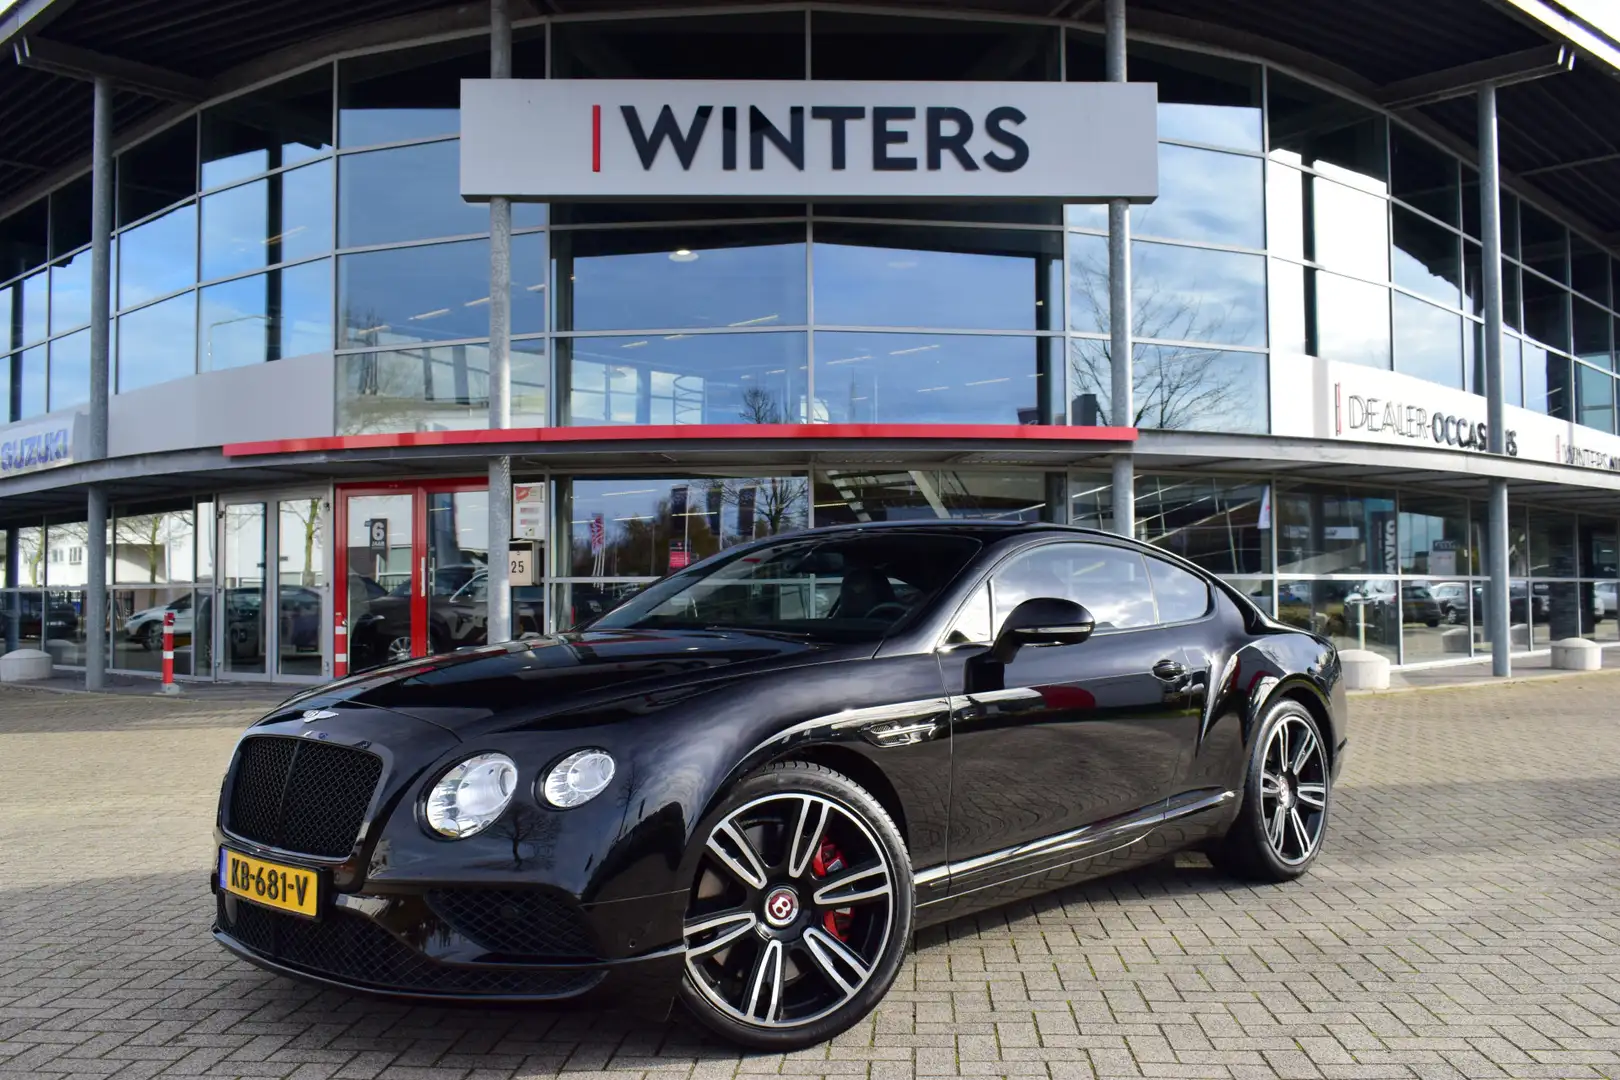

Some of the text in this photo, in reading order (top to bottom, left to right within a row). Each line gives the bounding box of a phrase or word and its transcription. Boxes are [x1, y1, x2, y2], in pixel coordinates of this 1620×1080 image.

[619, 104, 1030, 173] WINTERS
[1, 429, 68, 470] SUZUKI
[372, 521, 385, 541] 6
[511, 560, 524, 574] 25
[231, 858, 308, 906] KB-681-V
